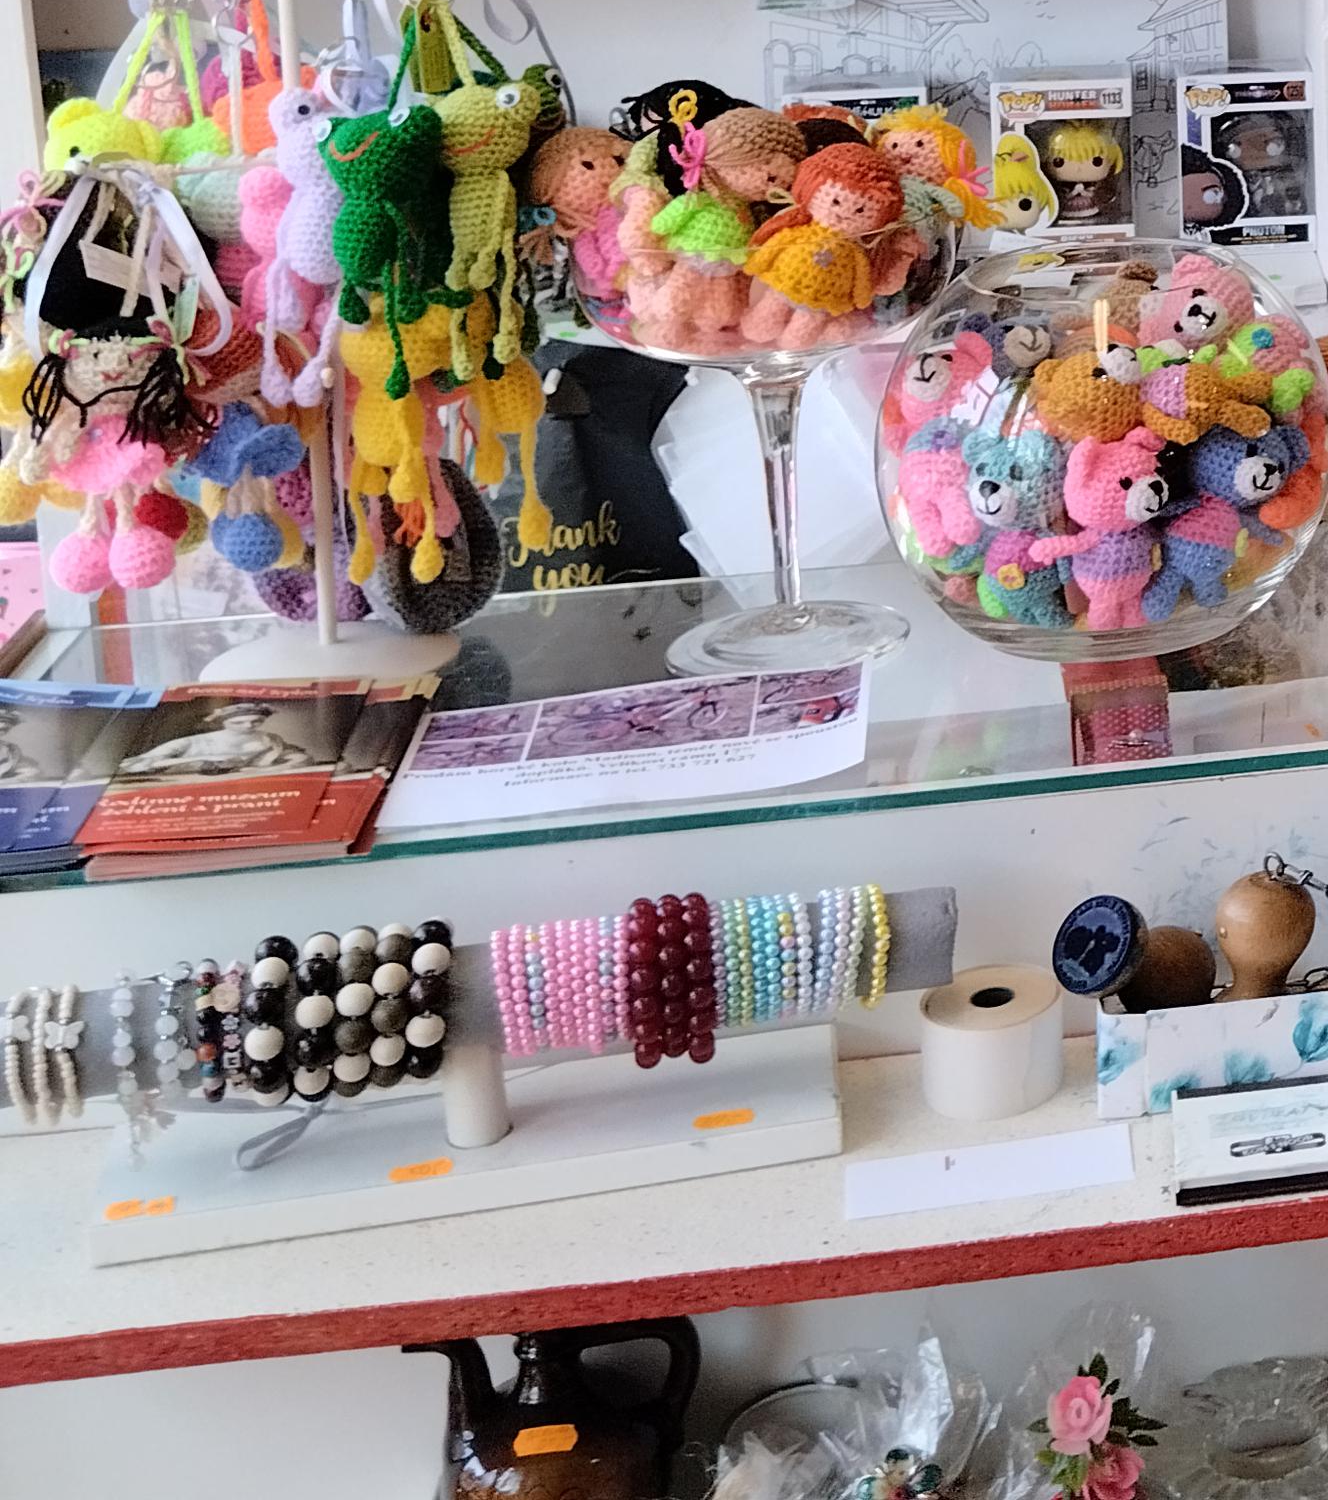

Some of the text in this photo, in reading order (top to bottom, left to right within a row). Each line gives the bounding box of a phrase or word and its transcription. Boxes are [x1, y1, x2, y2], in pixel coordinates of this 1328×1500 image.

[998, 91, 1043, 111] POP!
[1048, 91, 1097, 100] HUNTER
[533, 562, 604, 617] you
